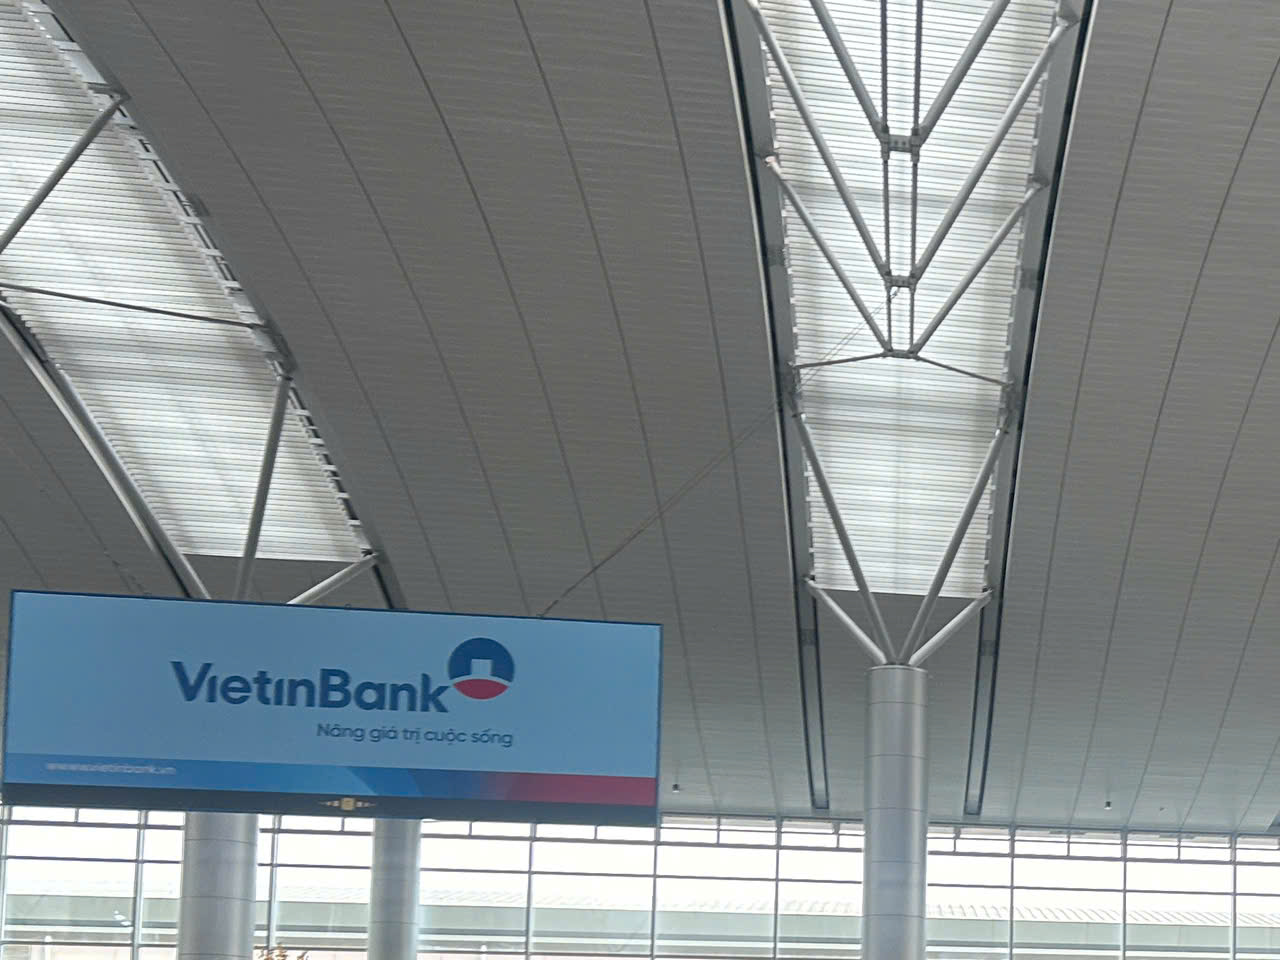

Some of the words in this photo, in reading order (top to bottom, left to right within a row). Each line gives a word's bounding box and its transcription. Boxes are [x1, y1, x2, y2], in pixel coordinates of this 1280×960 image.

[170, 660, 449, 713] VietinBank
[316, 723, 365, 743] Nâng
[369, 725, 398, 743] giá
[424, 728, 467, 746] cuộc
[471, 728, 514, 748] sống
